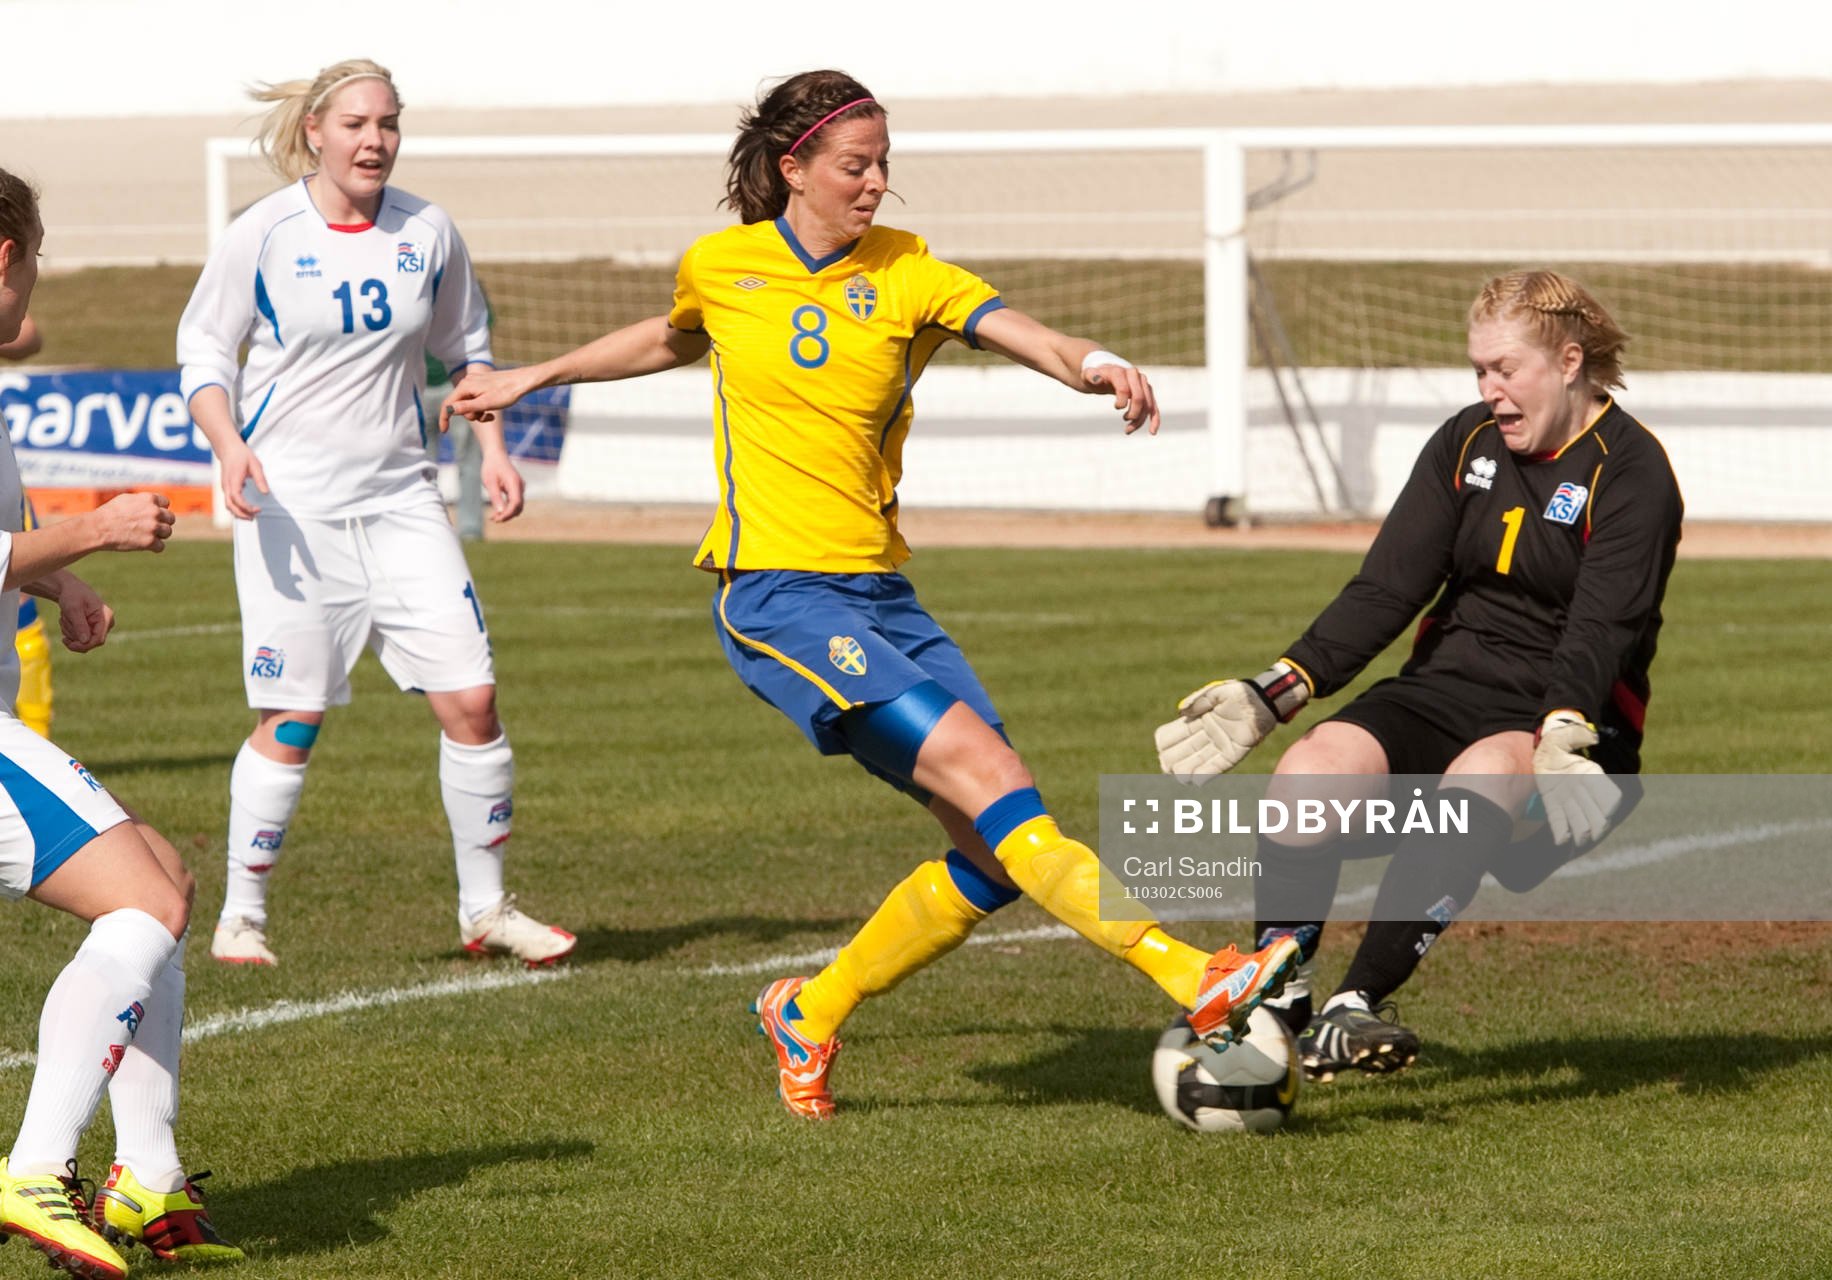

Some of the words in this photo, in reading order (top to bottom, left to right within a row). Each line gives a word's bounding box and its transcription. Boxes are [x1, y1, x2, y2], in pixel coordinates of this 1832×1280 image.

[332, 277, 392, 334] 13
[789, 303, 830, 369] 8
[0, 373, 212, 451] Garve
[1496, 506, 1526, 575] 1
